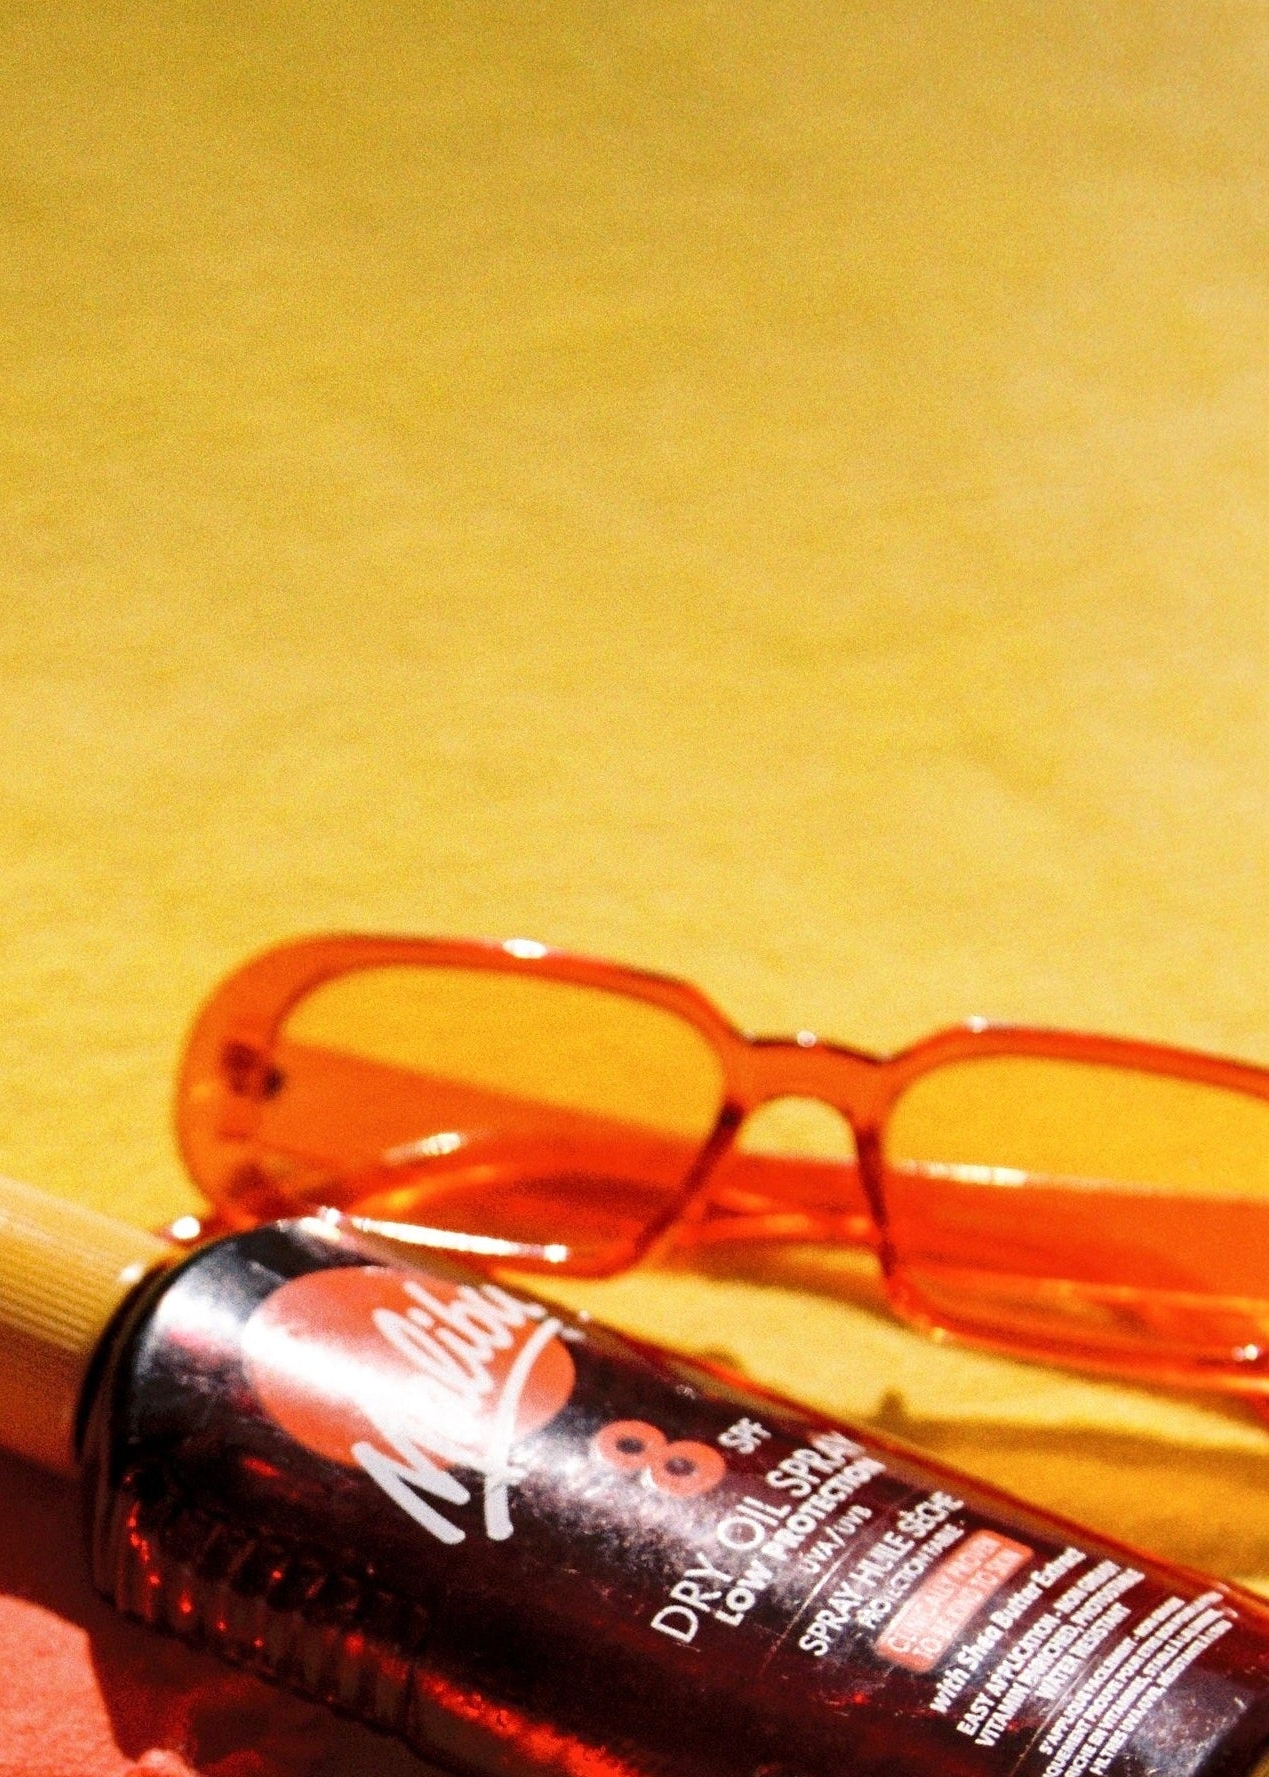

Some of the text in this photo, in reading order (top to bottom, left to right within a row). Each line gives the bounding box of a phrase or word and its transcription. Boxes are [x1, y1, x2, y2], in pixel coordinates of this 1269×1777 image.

[351, 1281, 562, 1544] Mlibu
[594, 1420, 727, 1496] 8
[651, 1431, 865, 1643] DRY OIL SPRAY
[714, 1456, 886, 1626] LOW PROTECTION
[798, 1580, 870, 1657] SPRAY
[848, 1531, 915, 1587] HUILE
[799, 1505, 872, 1574] UVA/UVB
[929, 1665, 971, 1714] with
[955, 1624, 1004, 1669] Shea
[988, 1581, 1043, 1628] Butter
[956, 1693, 996, 1735] EASY
[985, 1613, 1061, 1697] APPLICATION
[1035, 1654, 1082, 1701] WATER
[975, 1683, 1031, 1747] VITAMIN
